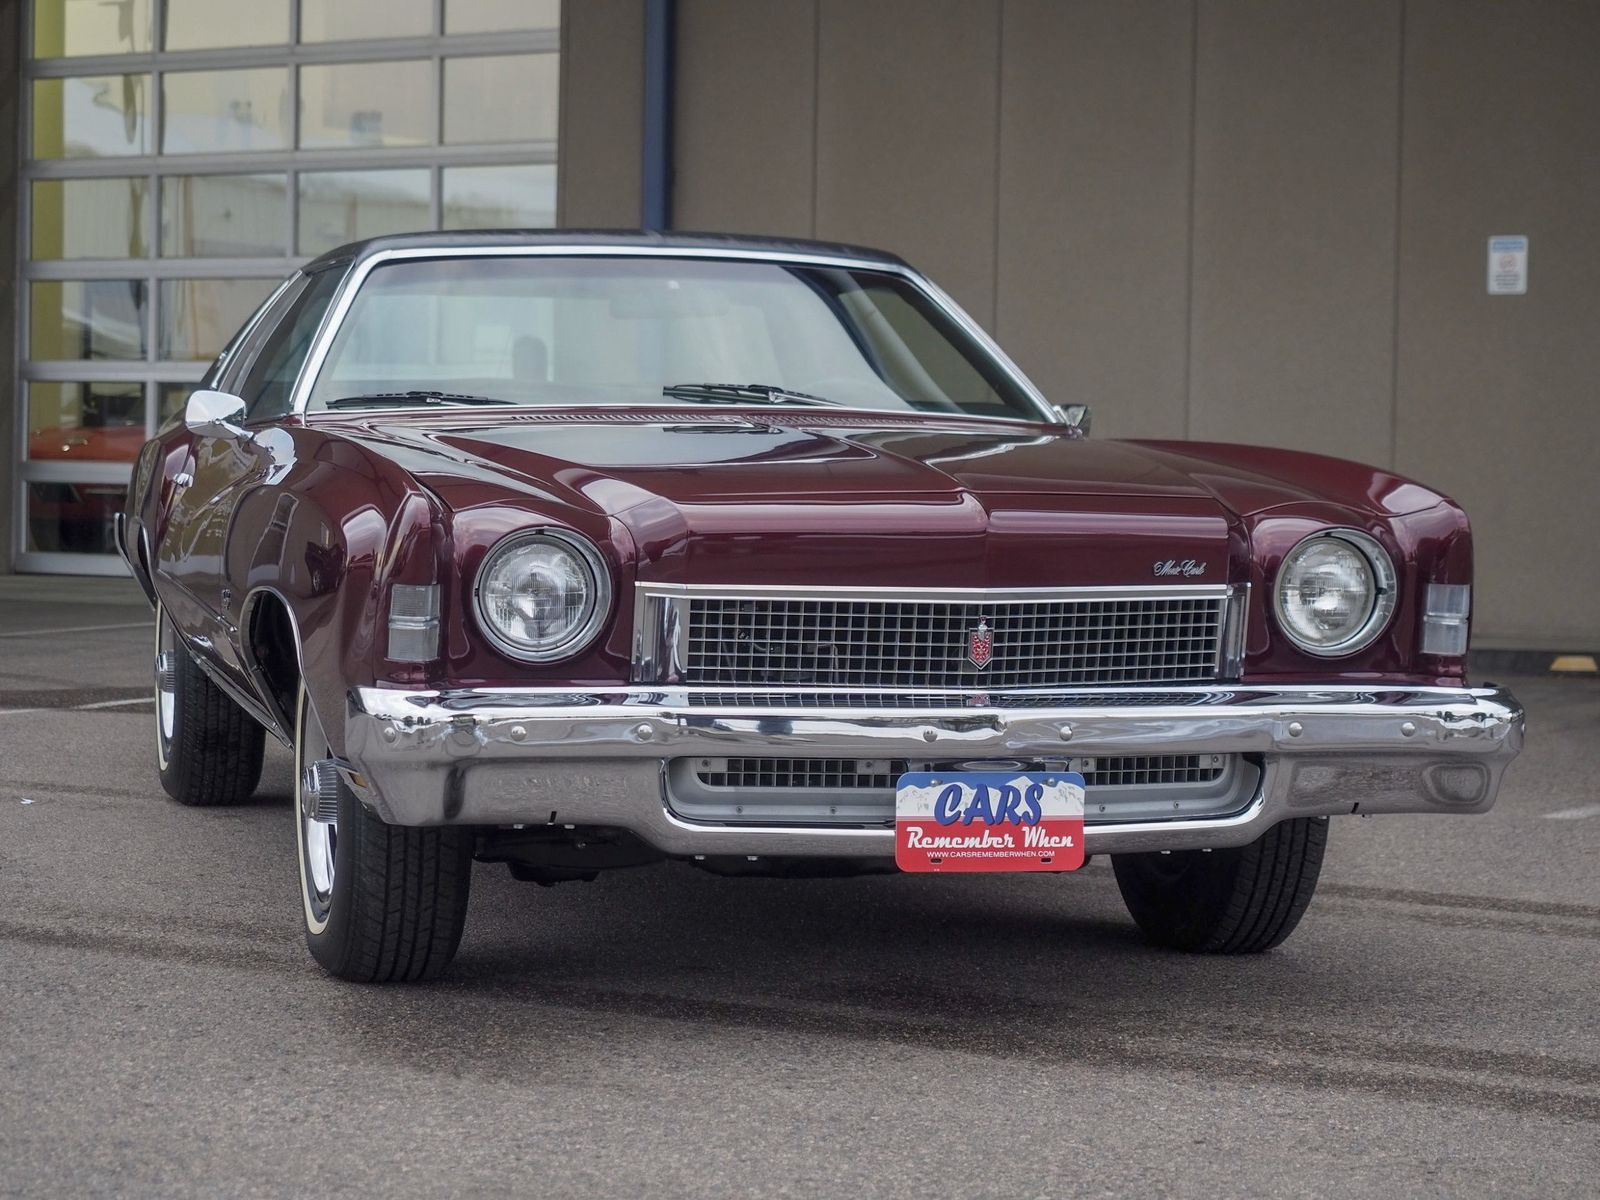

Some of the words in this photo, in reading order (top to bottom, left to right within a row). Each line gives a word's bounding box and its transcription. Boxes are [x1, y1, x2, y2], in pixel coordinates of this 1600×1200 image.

[934, 783, 1043, 826] CARS
[906, 827, 1015, 849] Remember
[1021, 827, 1074, 848] When
